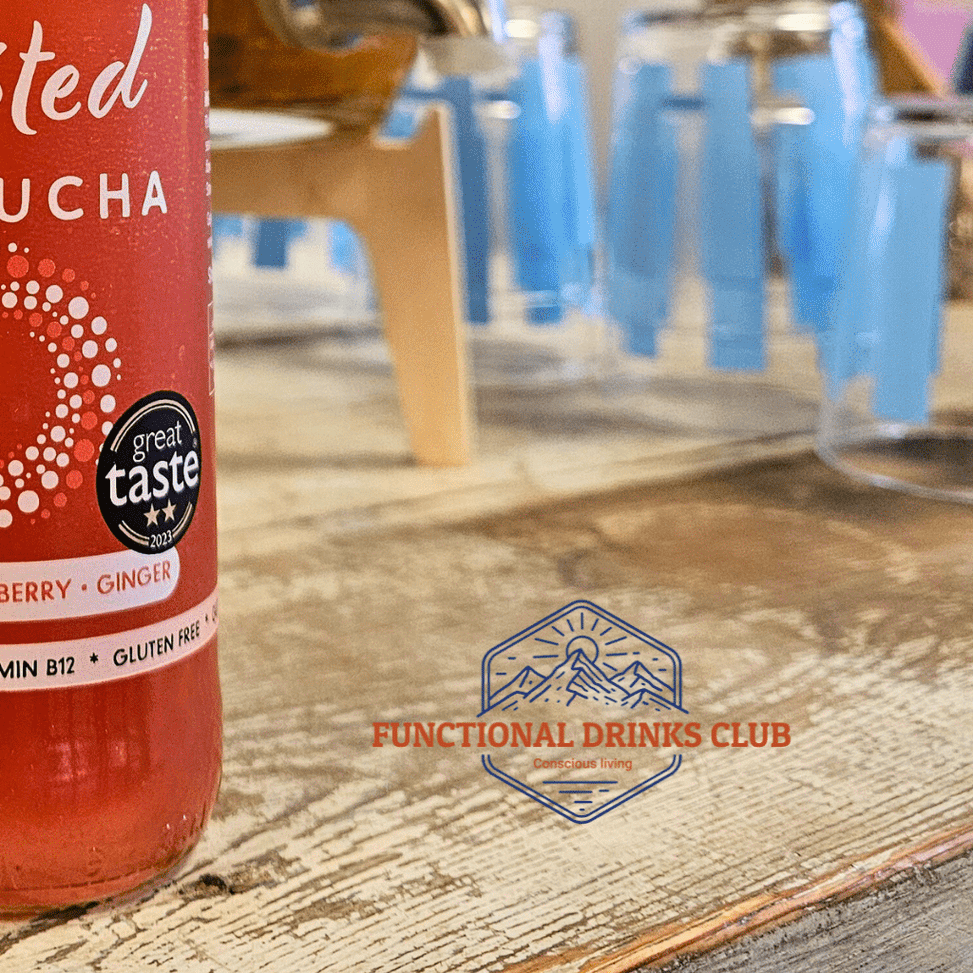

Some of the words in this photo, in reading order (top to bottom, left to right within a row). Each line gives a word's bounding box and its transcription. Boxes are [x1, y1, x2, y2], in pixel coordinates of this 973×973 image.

[132, 420, 182, 463] great
[105, 450, 199, 507] taste
[150, 530, 173, 548] 2023
[96, 560, 171, 595] GINGER
[46, 656, 75, 676] B12
[113, 634, 174, 667] GLUTEN
[178, 620, 200, 647] FREE
